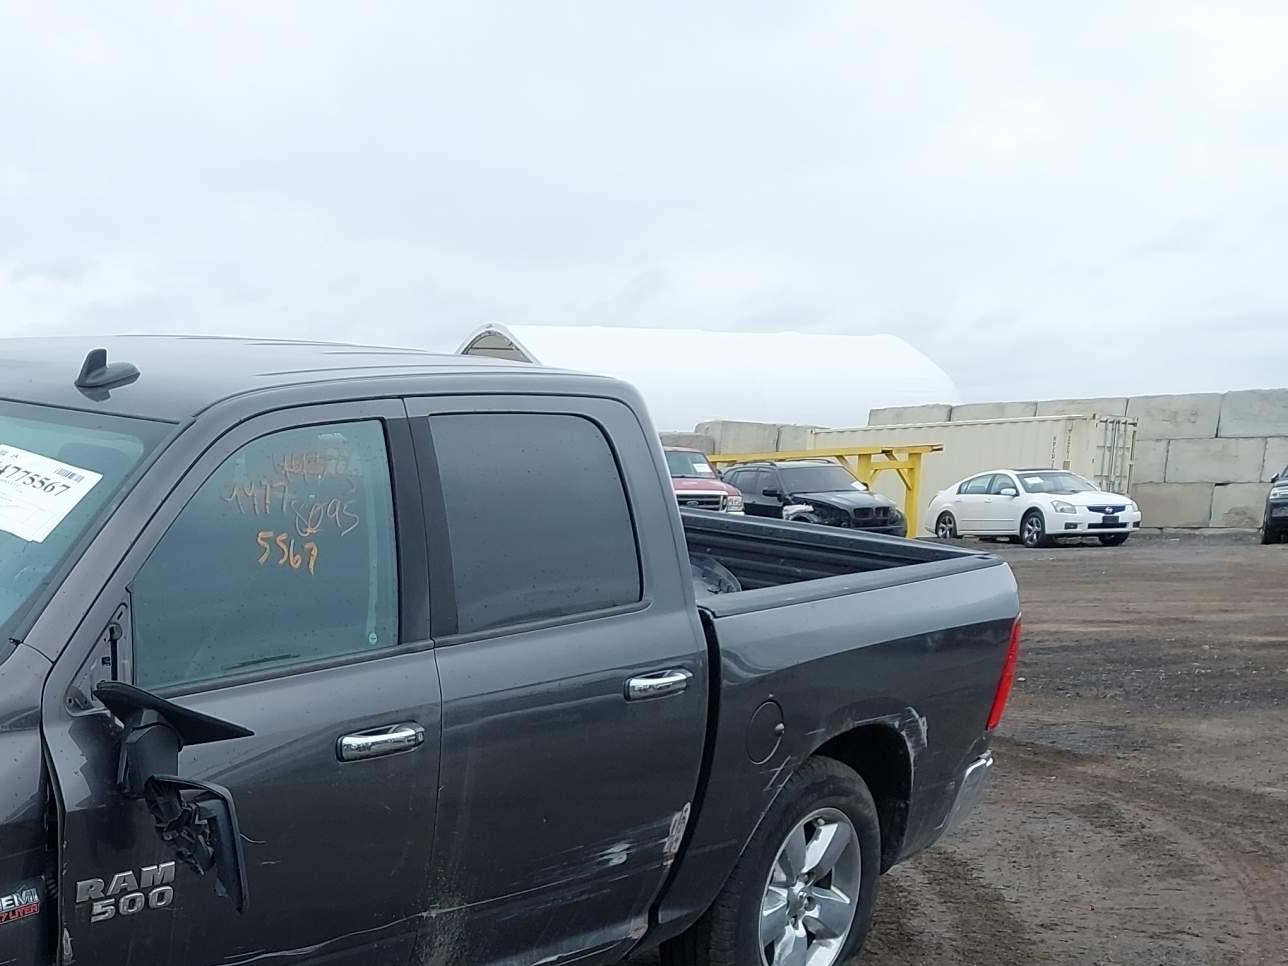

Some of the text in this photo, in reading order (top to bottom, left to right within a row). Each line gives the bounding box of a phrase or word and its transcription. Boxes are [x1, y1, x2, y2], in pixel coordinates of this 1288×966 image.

[257, 530, 319, 577] 5567
[75, 861, 176, 904] RAM
[9, 904, 38, 921] LITER
[91, 886, 174, 923] 500
